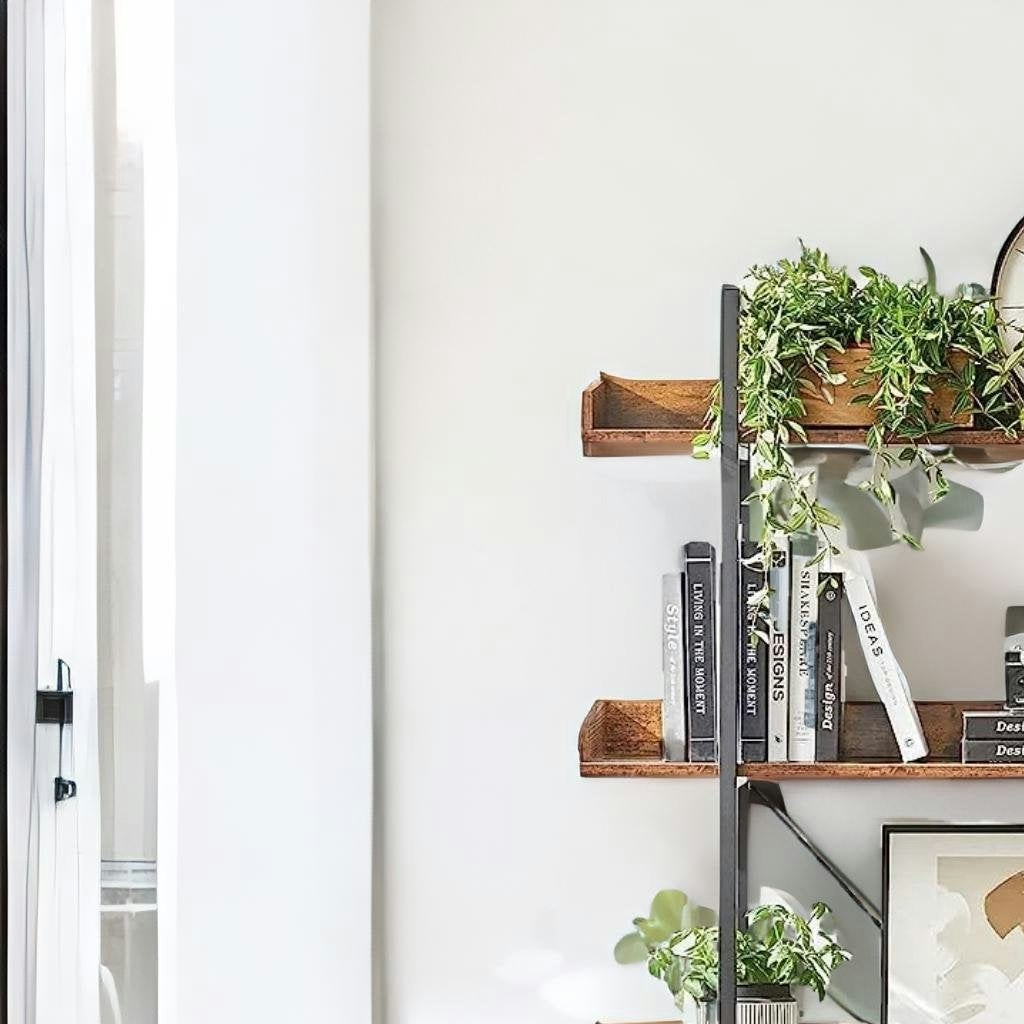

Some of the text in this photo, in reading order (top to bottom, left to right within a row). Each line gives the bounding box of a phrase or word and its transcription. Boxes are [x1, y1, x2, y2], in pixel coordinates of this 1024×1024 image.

[663, 603, 680, 651] Style
[693, 583, 706, 715] LIVING IN THE MOMENT
[858, 604, 884, 658] IDEAS
[772, 620, 785, 702] ESIGNS
[746, 668, 758, 716] MOMENT
[822, 683, 837, 731] Design
